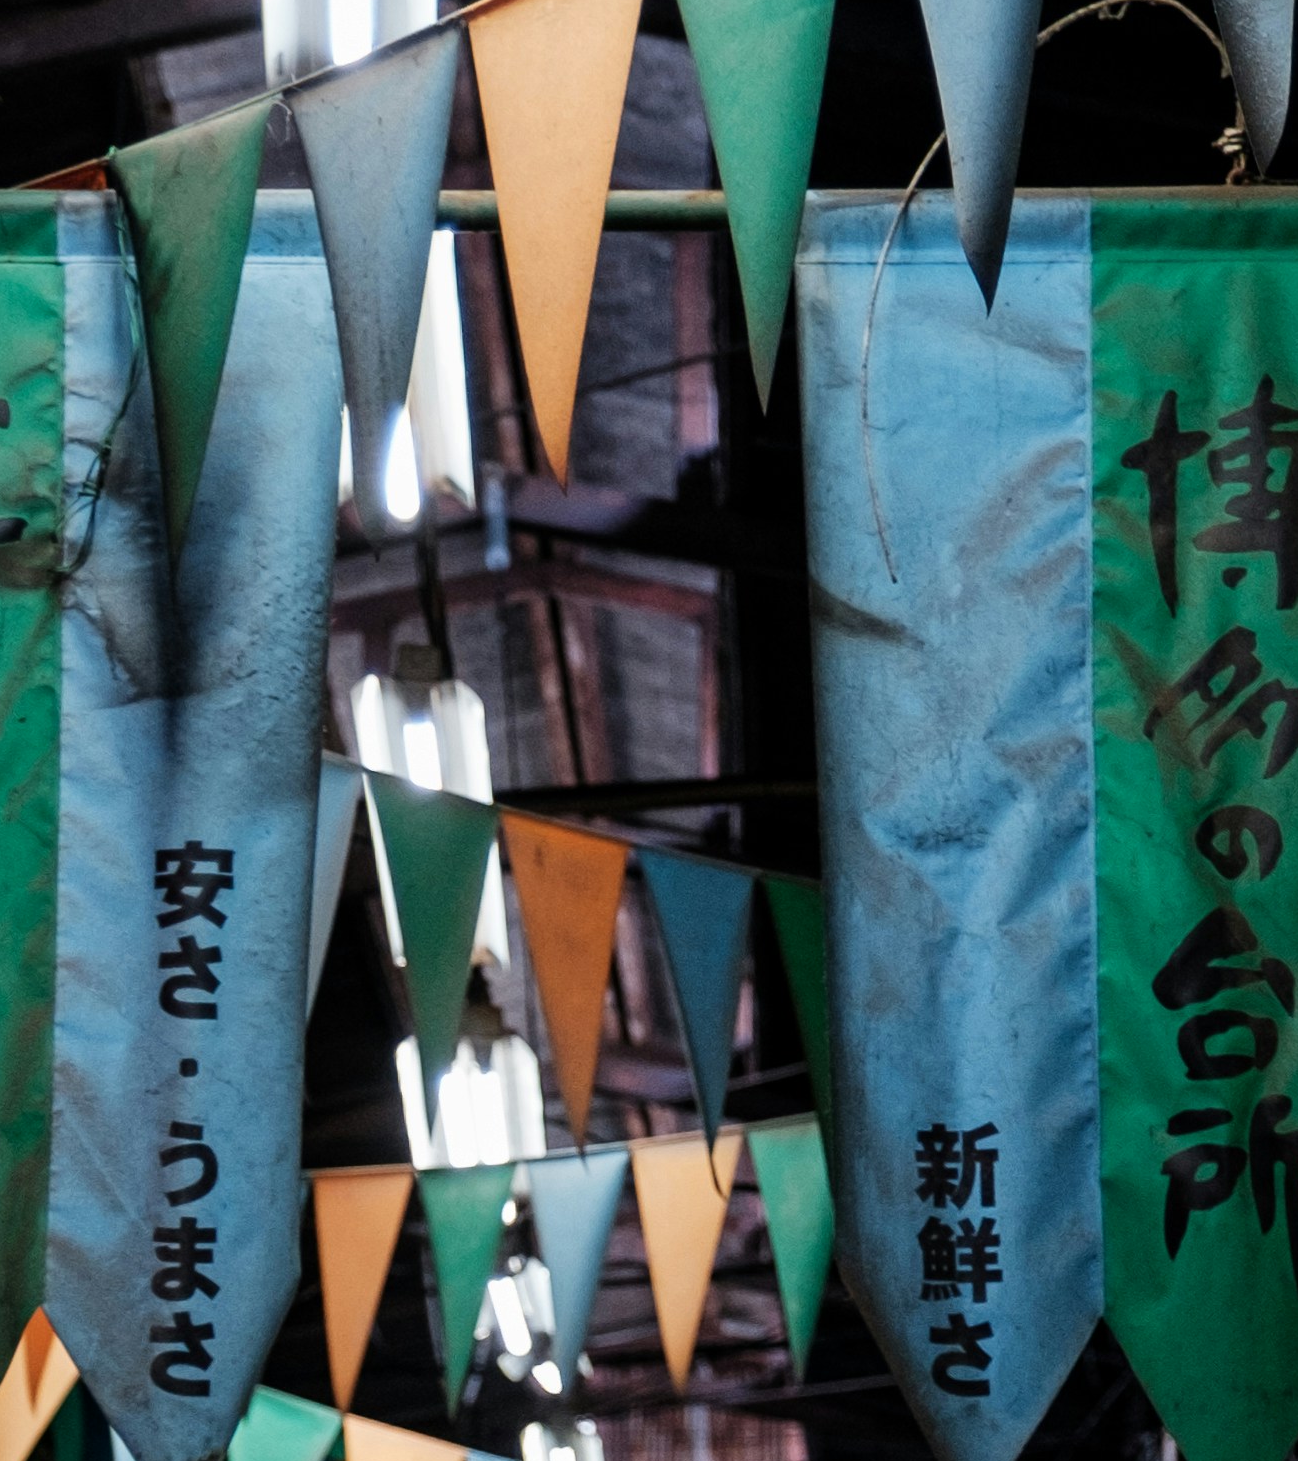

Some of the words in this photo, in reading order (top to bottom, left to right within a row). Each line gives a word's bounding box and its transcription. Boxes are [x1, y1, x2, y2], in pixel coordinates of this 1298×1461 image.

[152, 840, 237, 1398] 安さ・うまさ
[914, 1122, 1004, 1399] 新鮮さ
